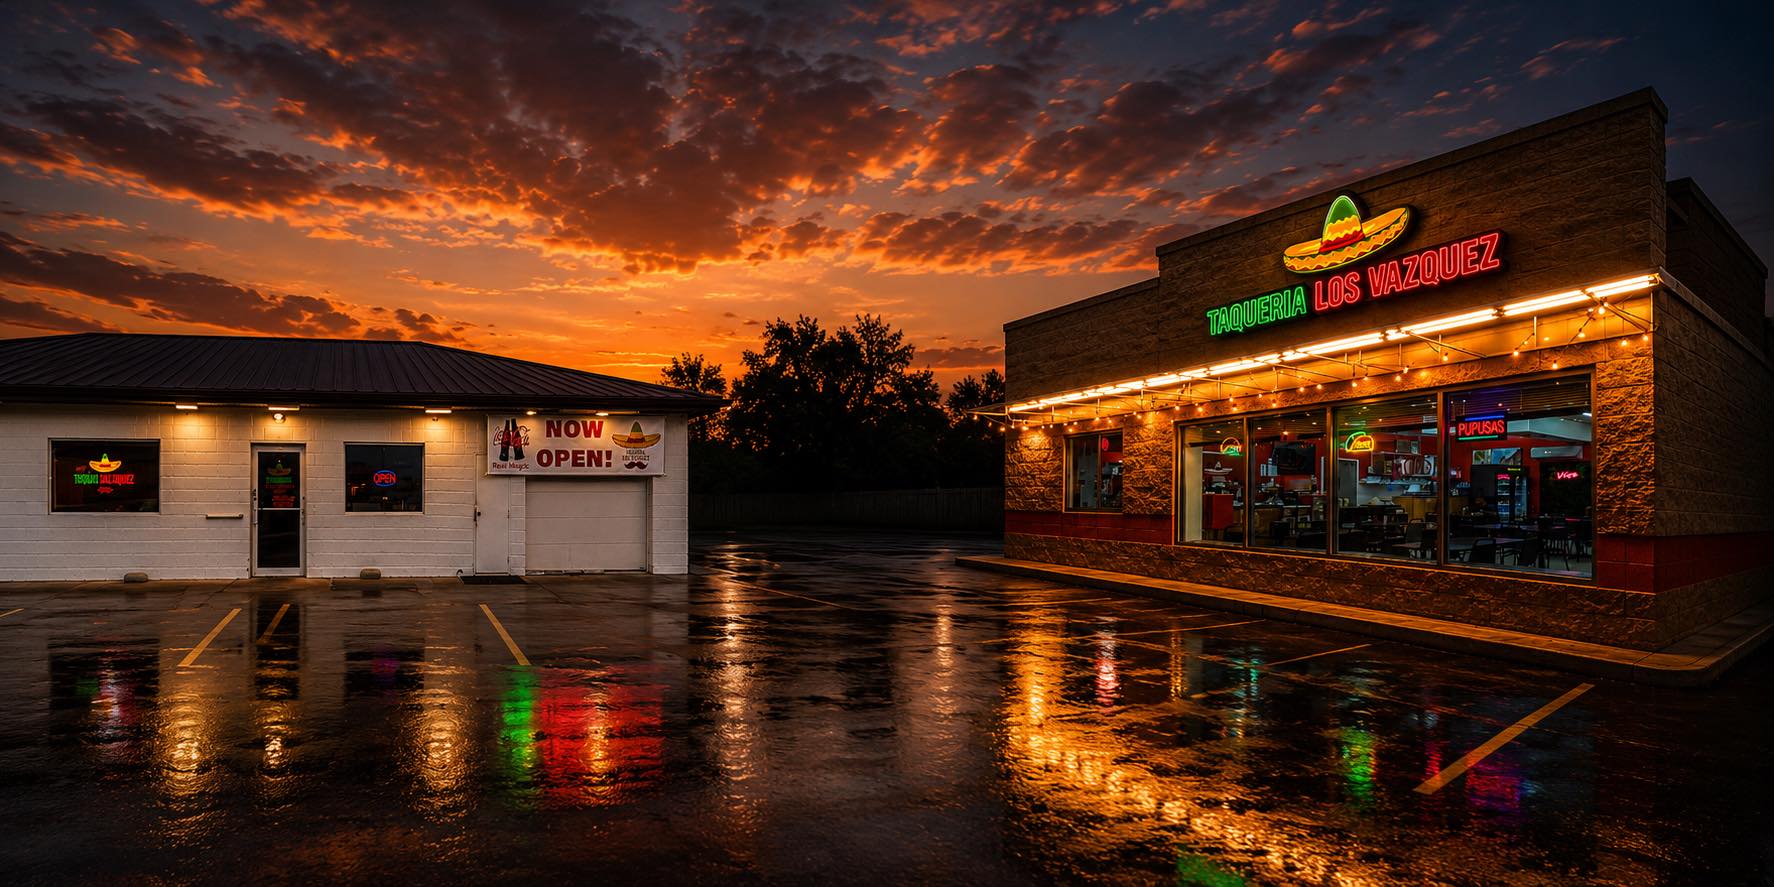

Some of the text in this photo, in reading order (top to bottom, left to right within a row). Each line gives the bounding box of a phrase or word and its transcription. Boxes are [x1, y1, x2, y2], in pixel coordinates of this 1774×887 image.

[1206, 232, 1500, 337] TAQUERIA LOS VAZQUEZ
[546, 420, 603, 438] NOW
[1458, 420, 1505, 436] PUPUSAS
[536, 449, 613, 468] OPEN!
[373, 473, 397, 485] OPEN
